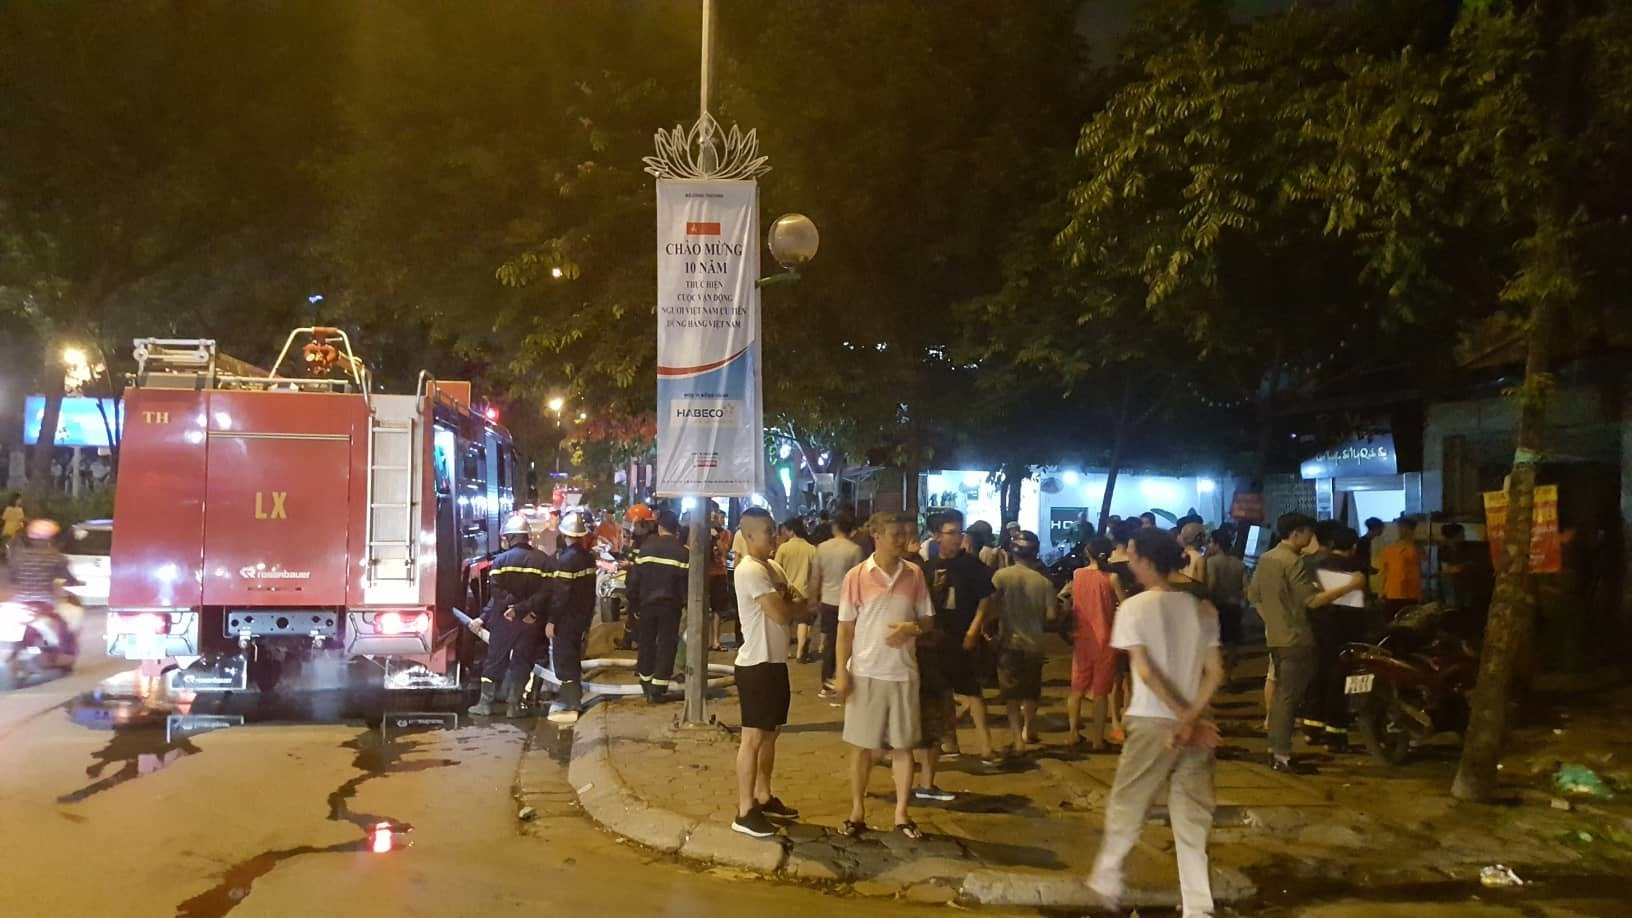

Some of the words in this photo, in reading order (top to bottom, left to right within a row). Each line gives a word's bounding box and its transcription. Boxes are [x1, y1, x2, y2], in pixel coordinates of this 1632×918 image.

[666, 240, 701, 255] CHÀO
[685, 262, 696, 274] 10
[700, 260, 727, 274] NĂM
[142, 411, 169, 424] TH
[677, 408, 724, 418] HABECO
[255, 491, 288, 520] LX
